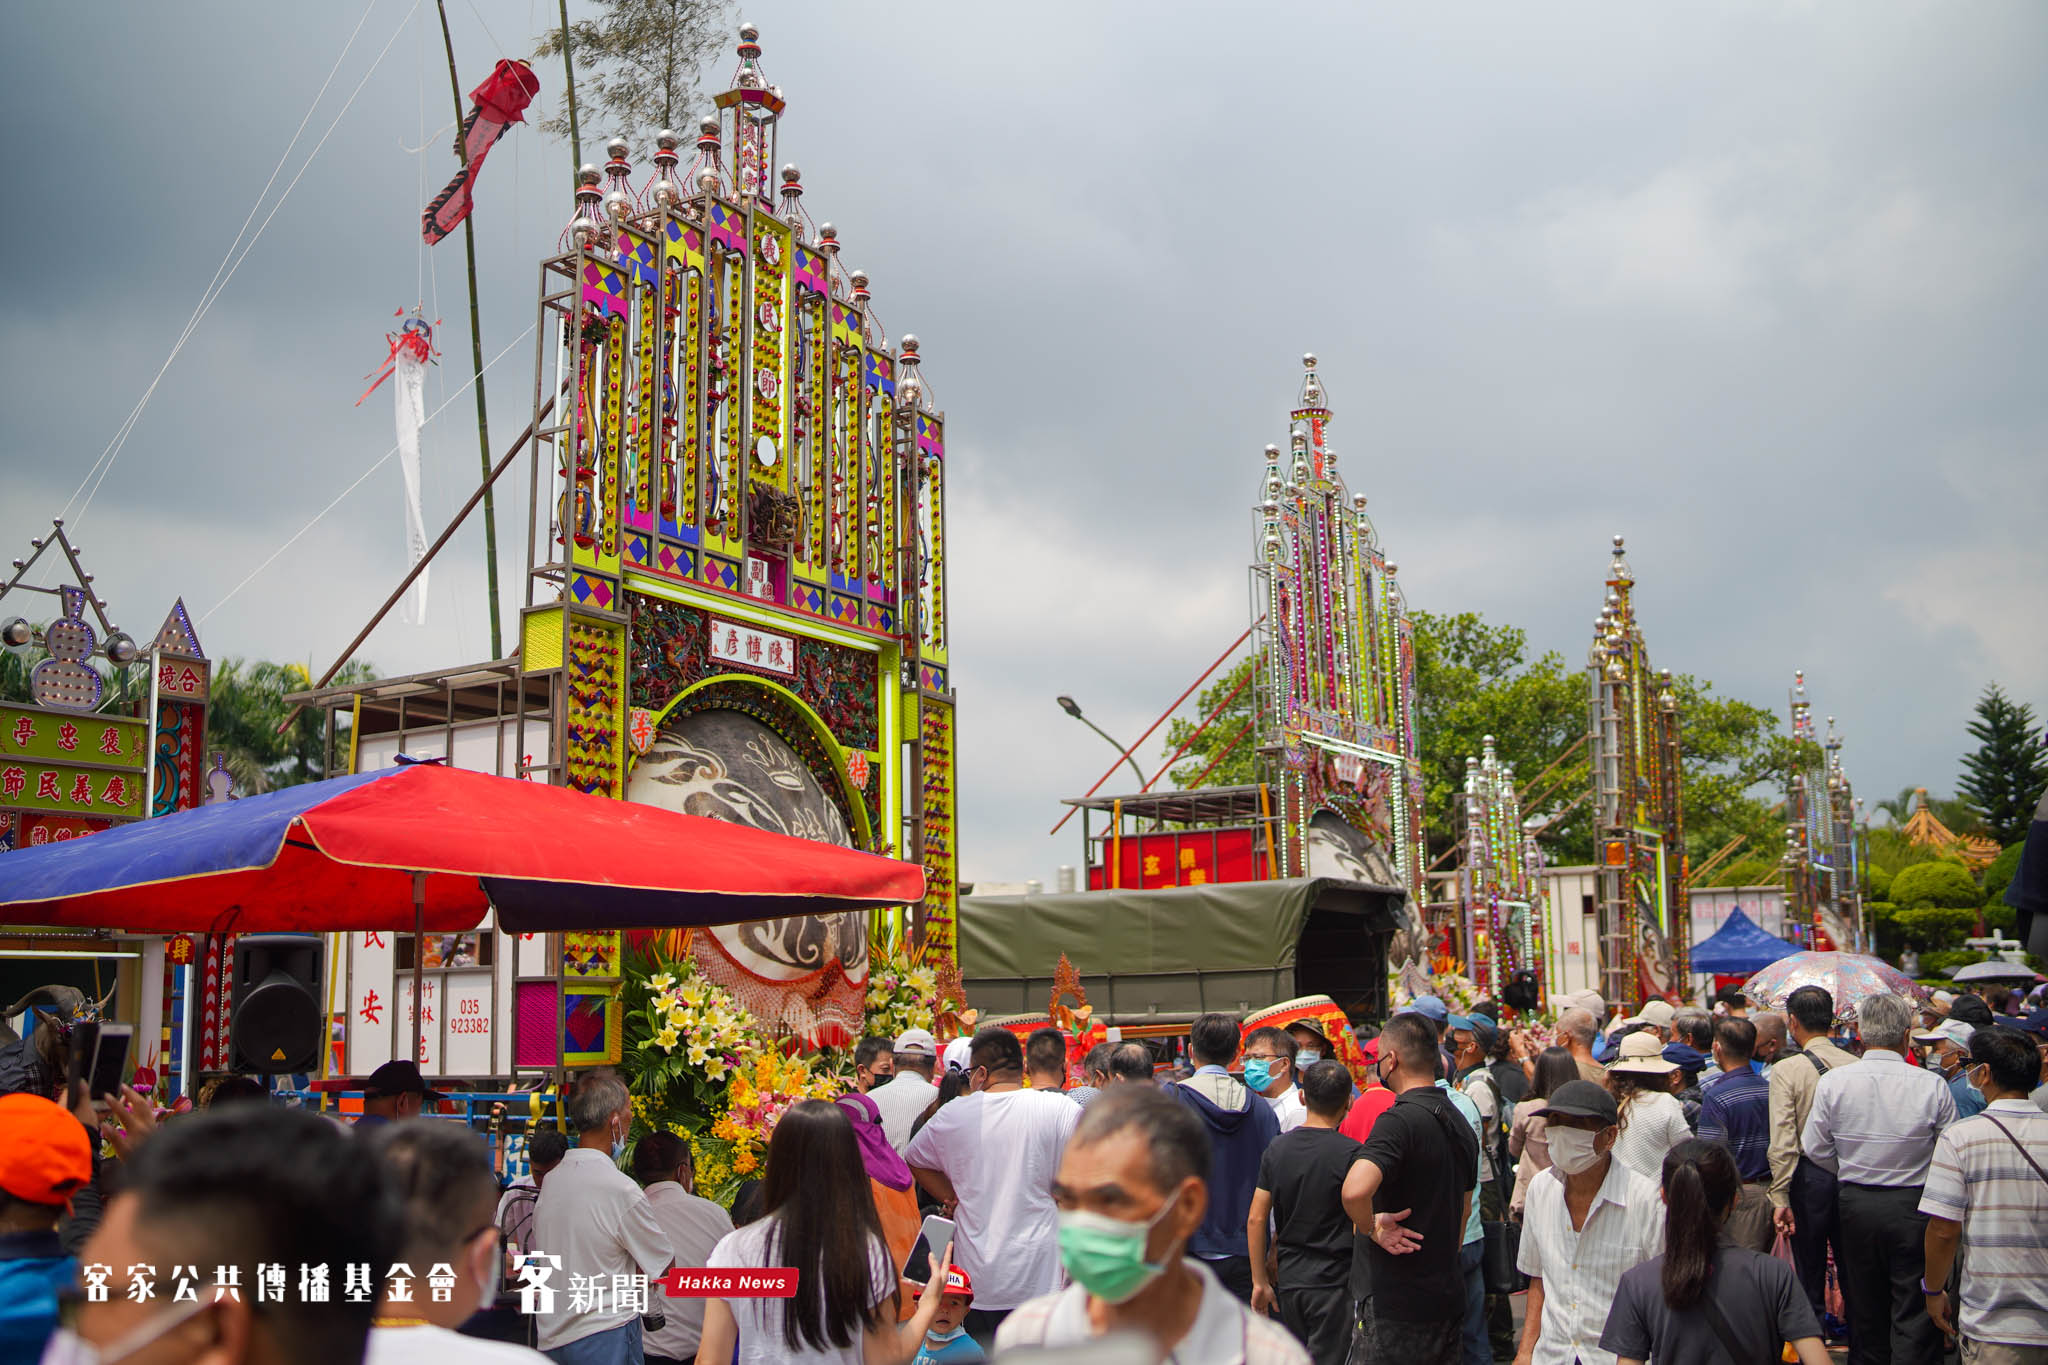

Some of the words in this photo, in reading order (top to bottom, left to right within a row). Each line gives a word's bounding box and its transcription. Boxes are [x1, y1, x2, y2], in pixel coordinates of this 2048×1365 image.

[159, 664, 201, 693] 合境
[13, 717, 123, 755] 褒忠亭
[2, 766, 128, 806] 慶義民節
[460, 999, 480, 1015] 035
[450, 1018, 489, 1034] 923382
